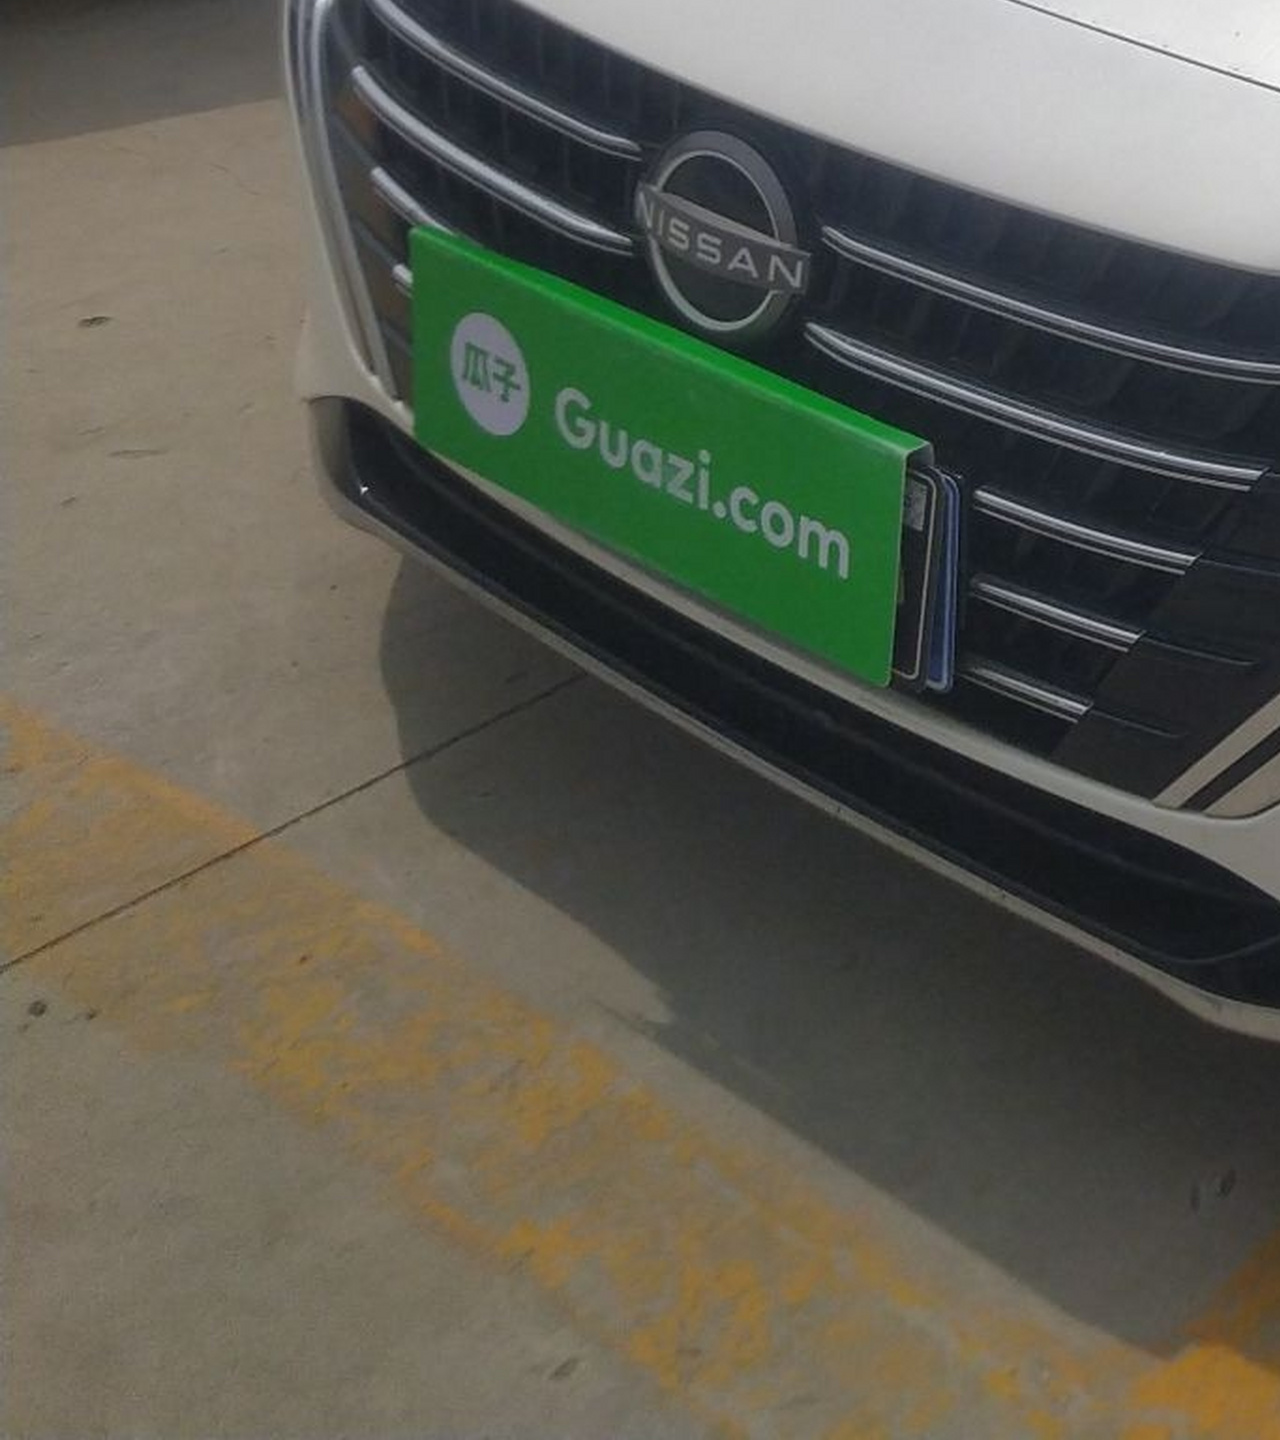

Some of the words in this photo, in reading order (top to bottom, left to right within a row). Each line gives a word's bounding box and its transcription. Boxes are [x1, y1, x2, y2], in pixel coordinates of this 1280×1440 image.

[638, 189, 804, 288] NISSAN
[463, 341, 521, 403] 瓜子
[554, 387, 851, 580] Guazi.com
